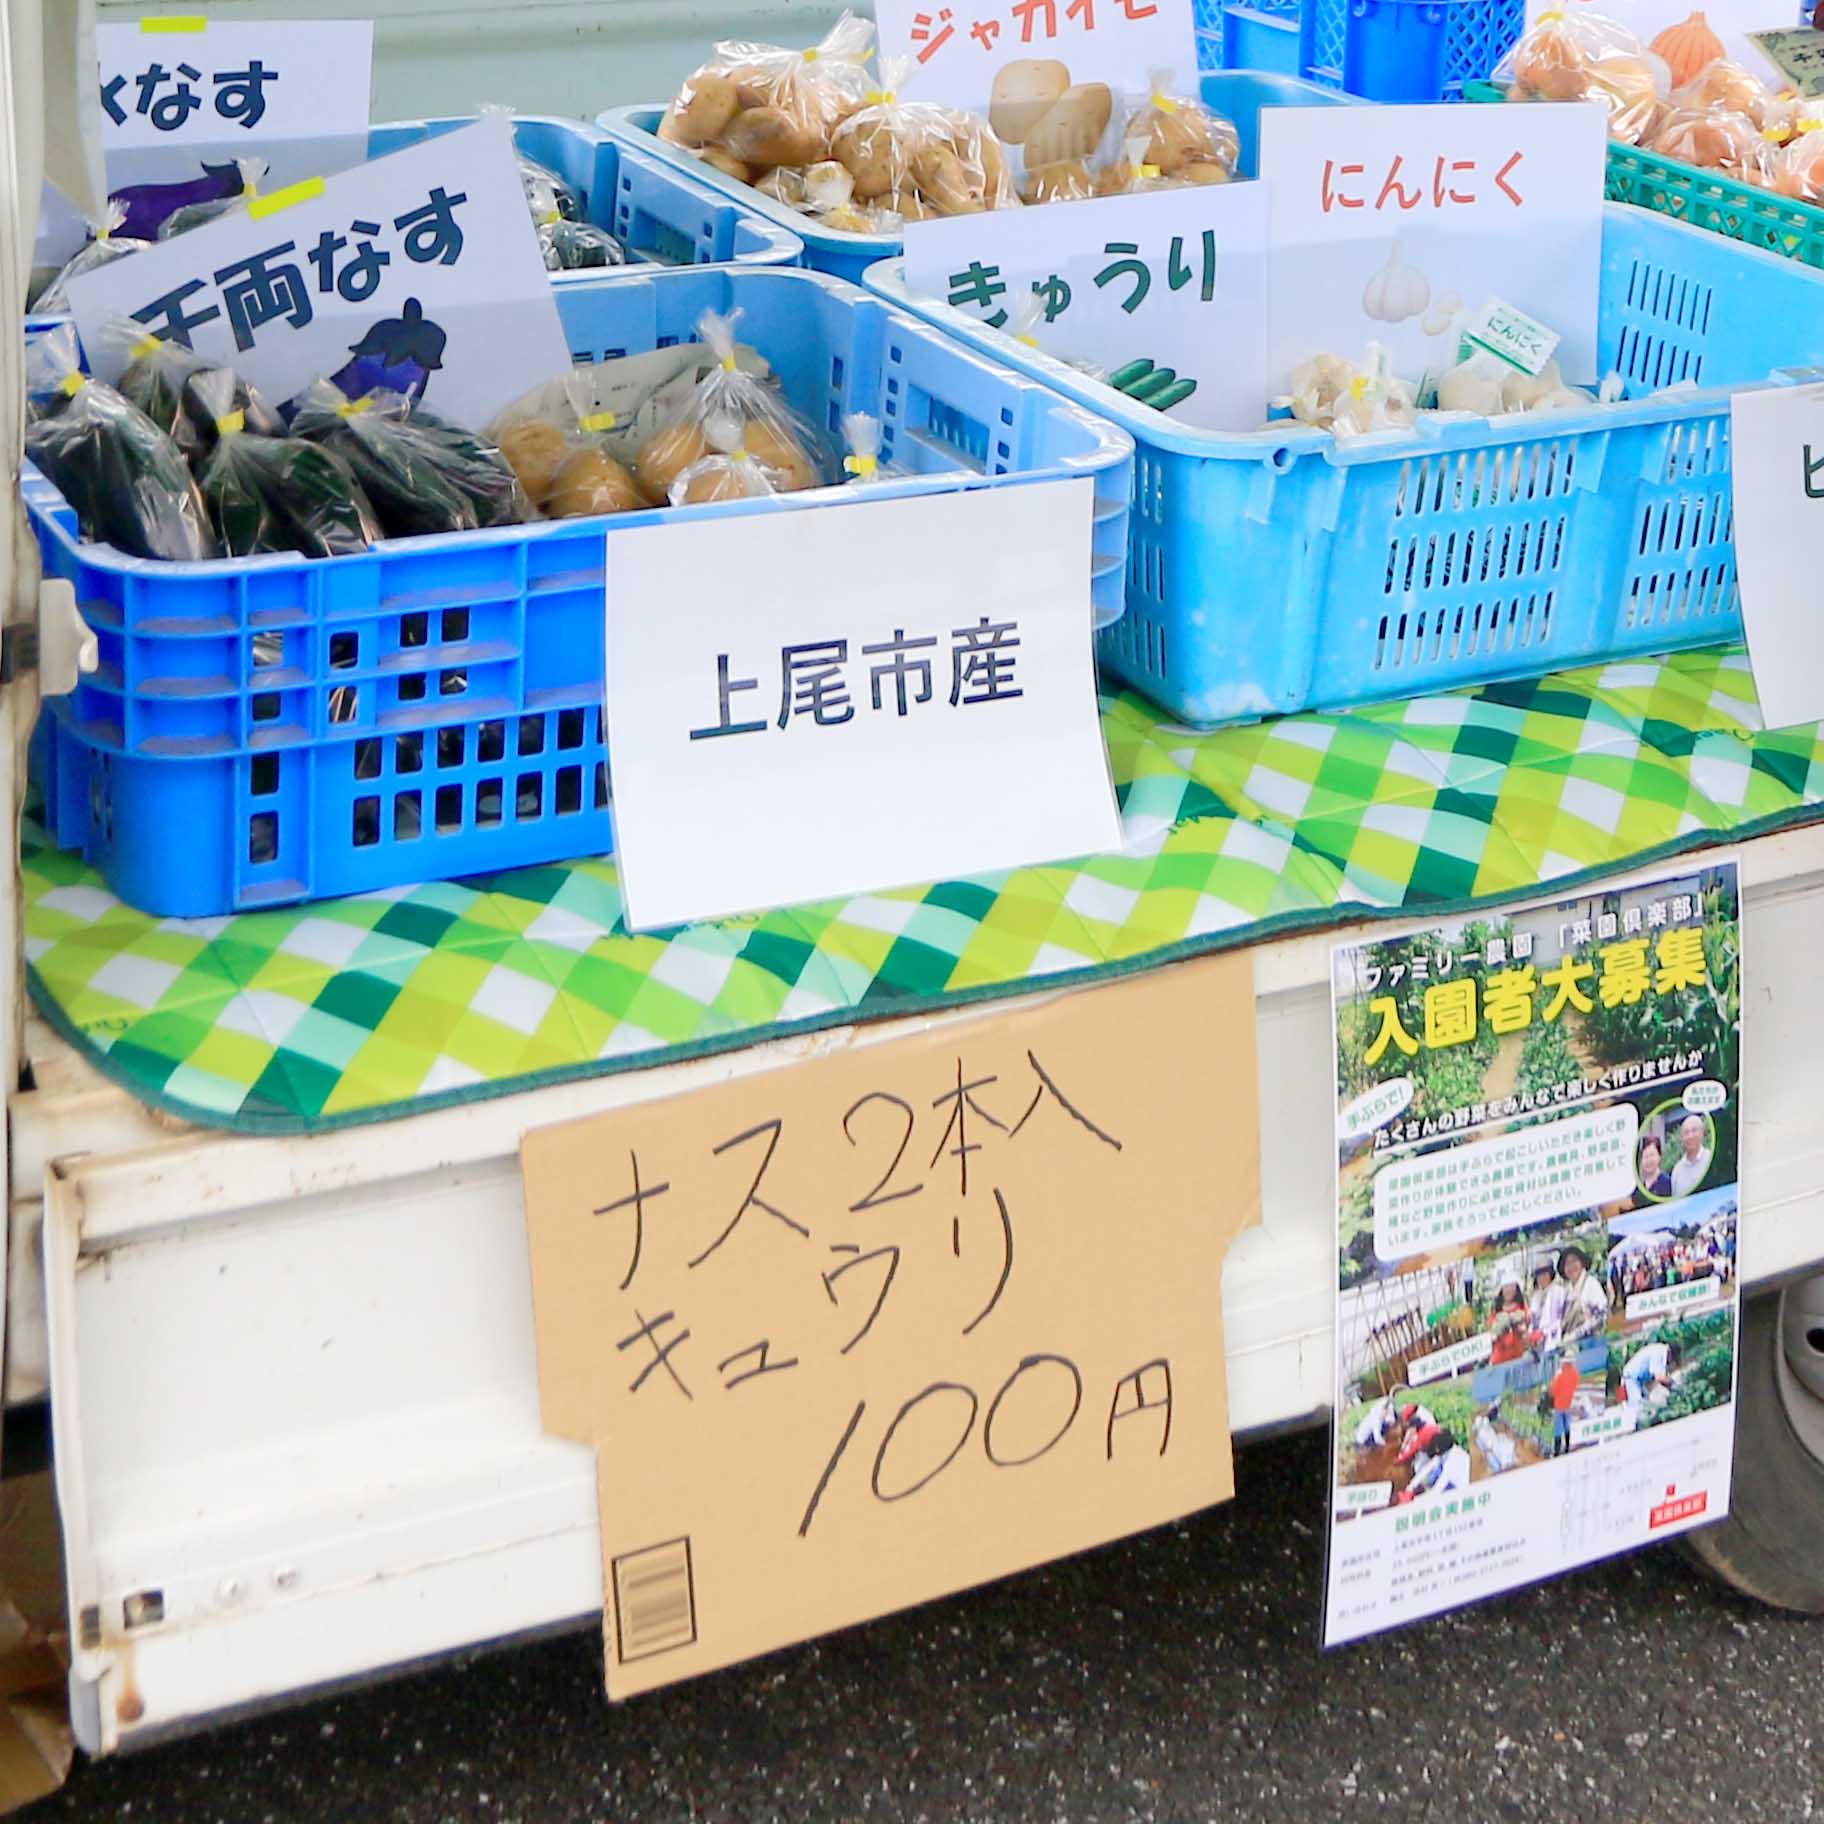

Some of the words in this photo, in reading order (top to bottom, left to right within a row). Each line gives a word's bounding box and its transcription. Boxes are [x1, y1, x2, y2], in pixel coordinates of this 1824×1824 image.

[1321, 151, 1526, 213] にんにく
[129, 186, 468, 353] 千両なす
[947, 229, 1218, 329] きゅうり
[1487, 316, 1543, 356] にんにく
[689, 617, 1024, 741] 上尾市産
[1363, 928, 1710, 1066] 入園者大募集
[1364, 933, 1534, 991] ファミリー農園
[1373, 1051, 1704, 1150] たくさんの野菜をみんなで楽しく作りませんか
[617, 1188, 1013, 1400] キュウリ
[798, 1354, 1174, 1537] 100円
